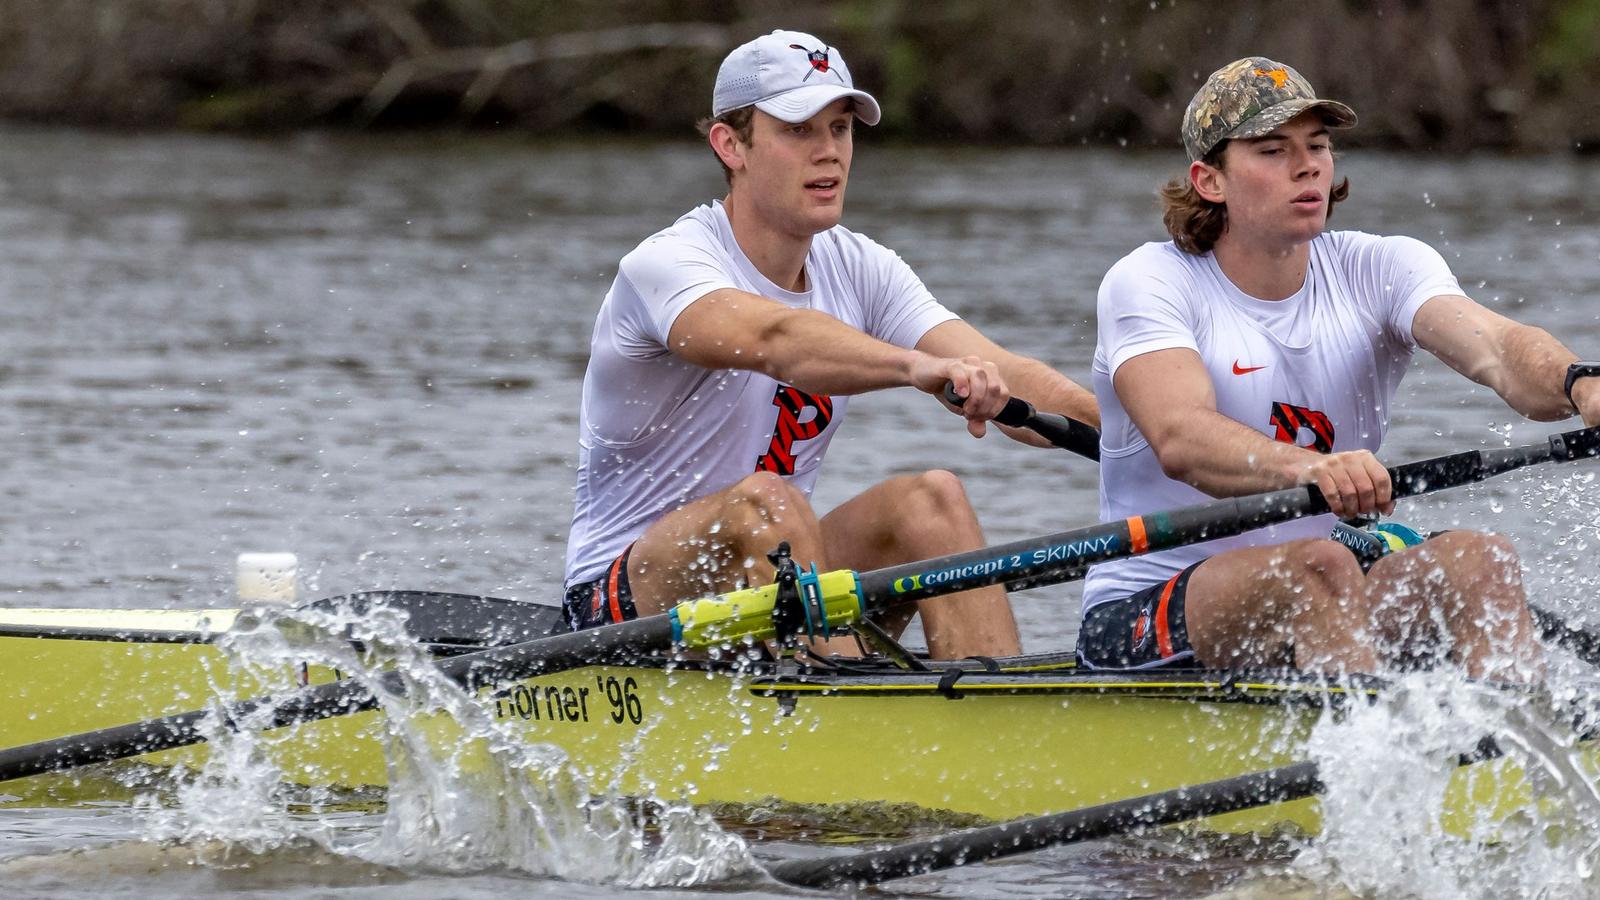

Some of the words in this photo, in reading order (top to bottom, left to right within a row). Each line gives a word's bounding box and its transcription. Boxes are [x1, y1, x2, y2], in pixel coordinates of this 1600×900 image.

[755, 384, 833, 476] P
[924, 559, 1005, 585] concept
[1010, 555, 1021, 568] 2
[1032, 535, 1114, 565] SKINNY
[1329, 527, 1369, 551] SKINNY
[597, 675, 643, 725] '96
